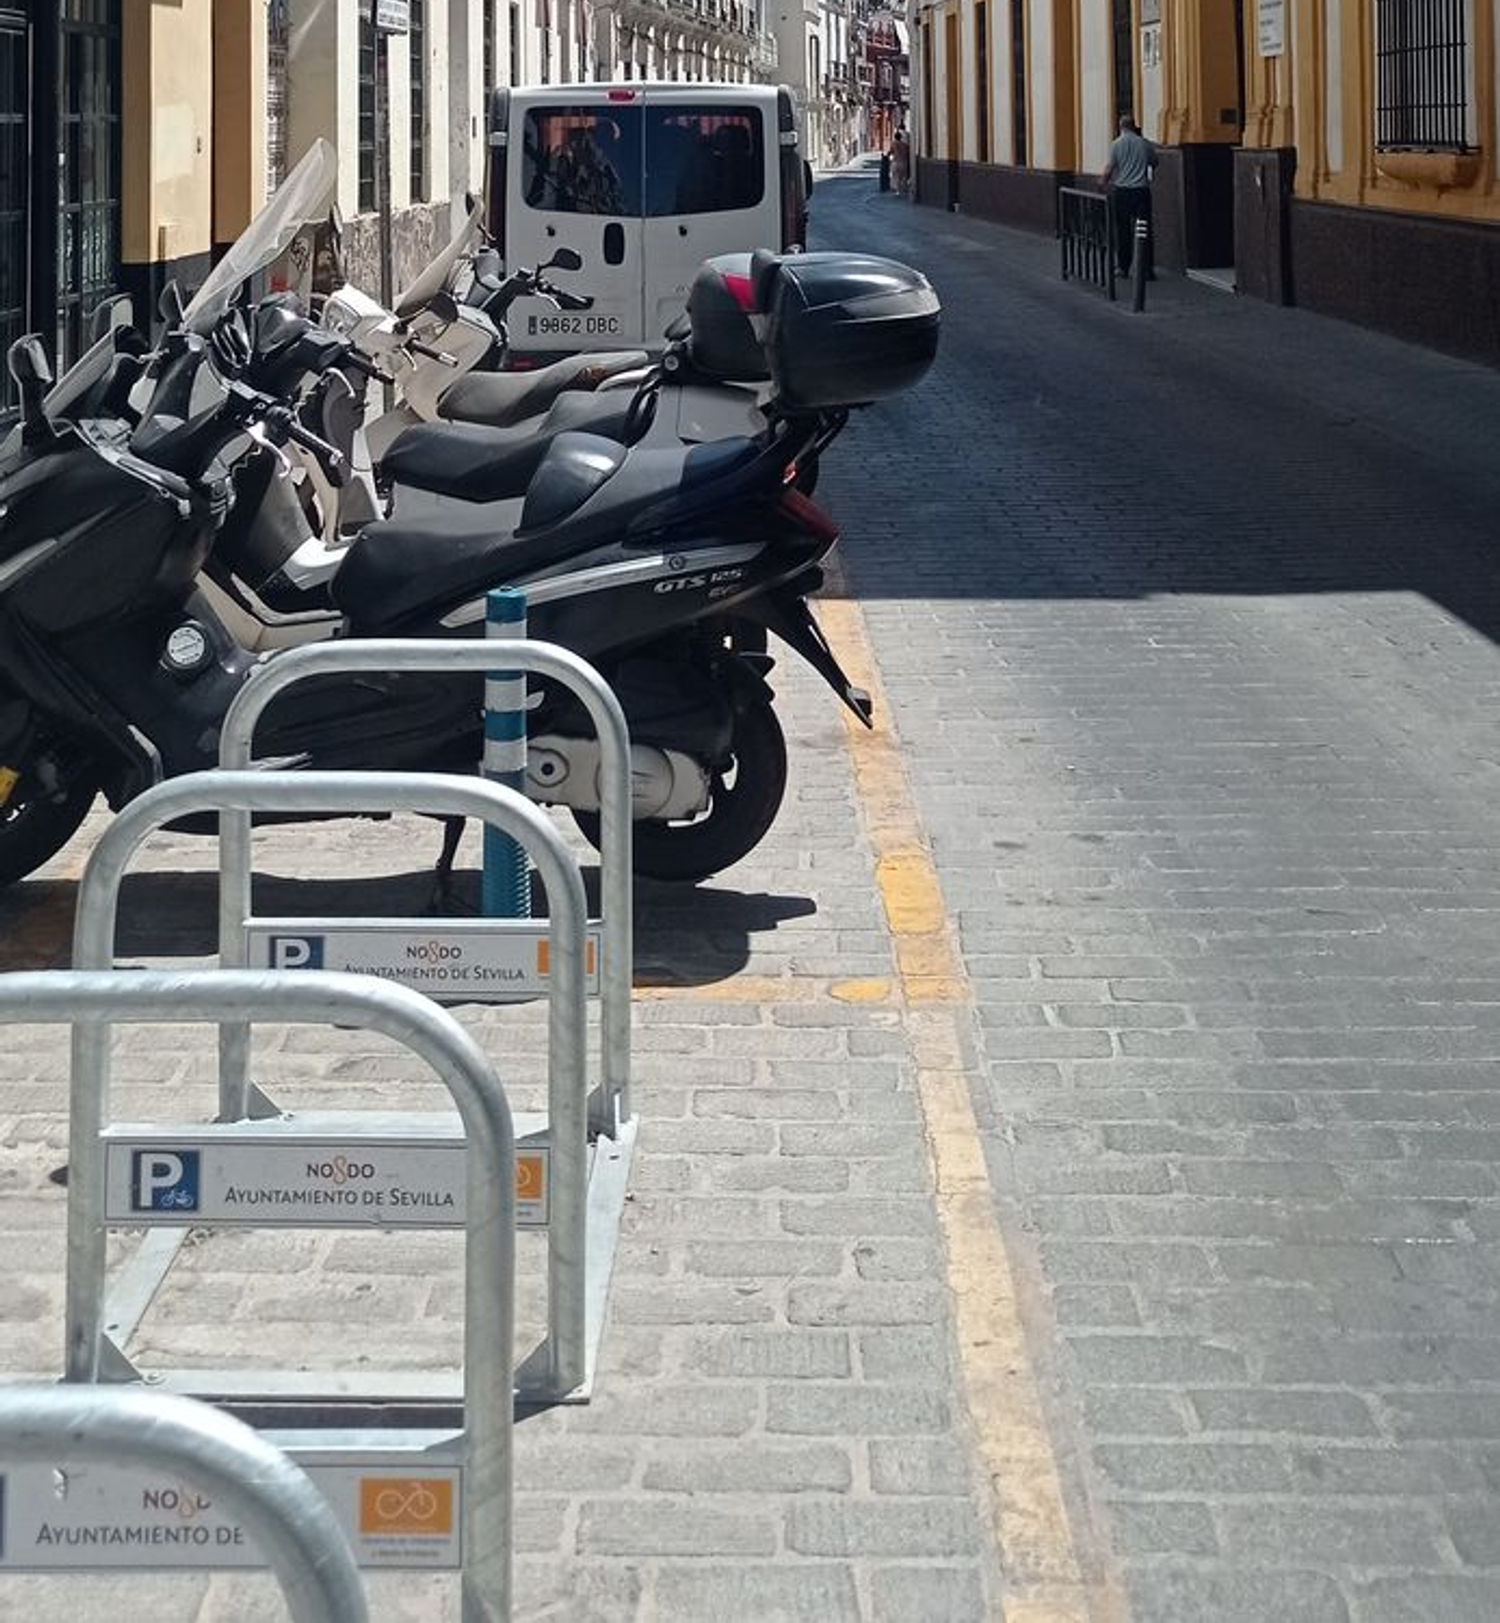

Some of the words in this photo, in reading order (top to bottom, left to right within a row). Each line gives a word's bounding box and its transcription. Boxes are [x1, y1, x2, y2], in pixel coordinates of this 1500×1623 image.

[586, 317, 619, 334] DBC
[141, 1153, 184, 1207] P
[362, 1190, 385, 1205] DE
[216, 1526, 244, 1545] DE
